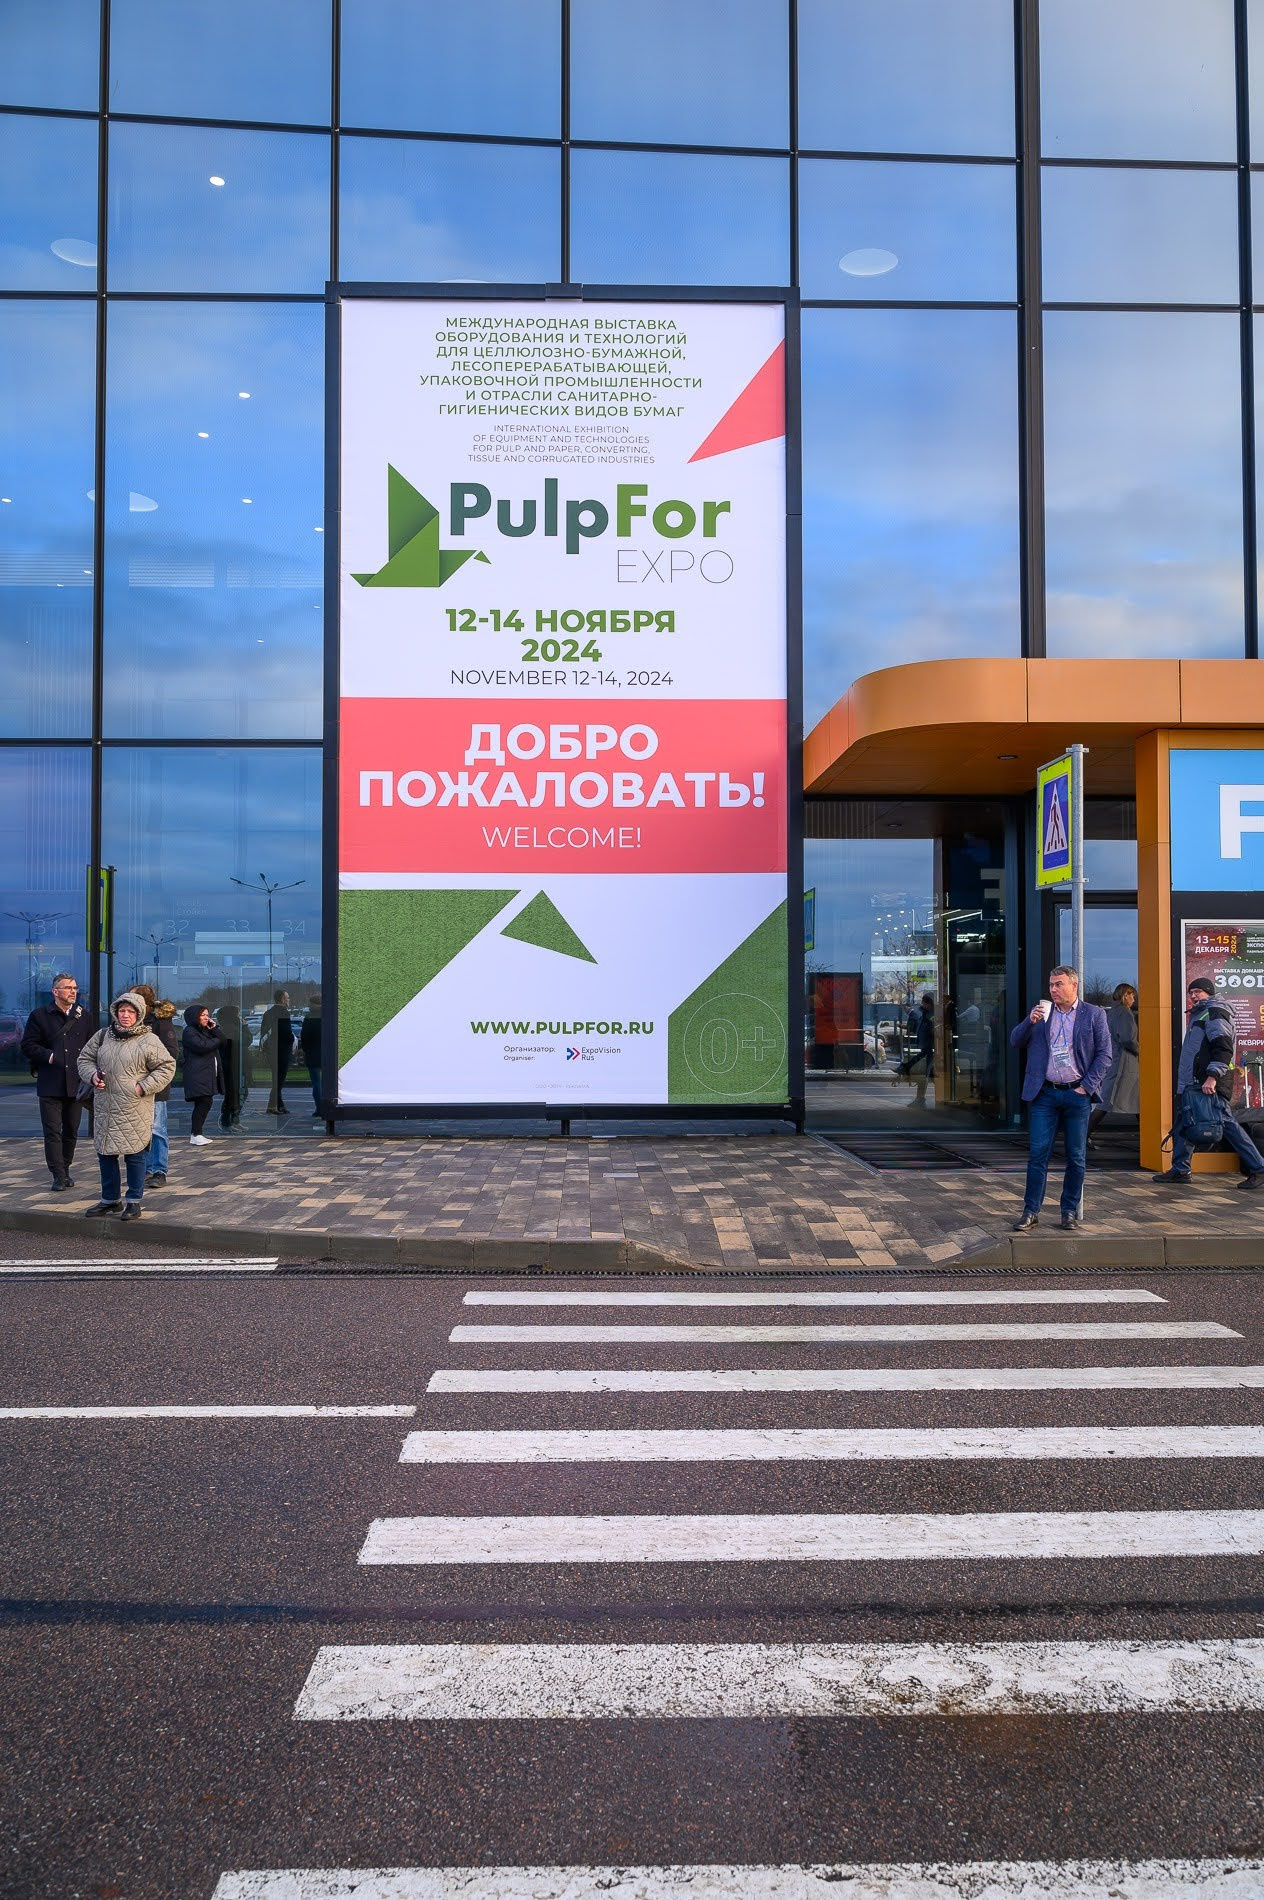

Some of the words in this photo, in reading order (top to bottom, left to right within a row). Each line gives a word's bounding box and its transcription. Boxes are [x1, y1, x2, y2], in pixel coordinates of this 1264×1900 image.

[446, 317, 589, 330] МЕЖДУНАРОДНАЯ
[595, 319, 676, 330] ВЫСТАВКА
[435, 332, 564, 344] ОБОРУДОВАНИЯ
[570, 333, 579, 344] И
[585, 331, 687, 344] ТЕХНОЛОГИЙ
[437, 346, 469, 359] ДЛЯ
[474, 345, 686, 361] ЦЕЛЛЮЛОЗНО-БУМАЖНОЙ,
[451, 360, 672, 376] ЛЕСОПЕРЕРАБАТЫВАЮЩЕЙ,
[420, 374, 539, 387] УПАКОВОЧНОЙ
[544, 376, 702, 388] ПРОМЫШЛЕННОСТИ
[465, 390, 475, 401] И
[481, 390, 552, 401] ОТРАСЛИ
[558, 391, 657, 402] САНИТАРНО-
[439, 404, 569, 415] ГИГИЕНИЧЕСКИХ
[575, 405, 628, 418] ВИДОВ
[633, 406, 684, 416] БУМАГ
[494, 425, 570, 433] INTERNATIONAL
[574, 425, 629, 433] EXHIBITION
[473, 435, 485, 443] OF
[489, 435, 546, 443] EQUIPMENT
[550, 435, 571, 443] AND
[524, 445, 545, 453] AND
[549, 445, 582, 454] PAPER,
[585, 446, 650, 454] CONVERTING,
[468, 455, 498, 463] TISSUE
[501, 455, 523, 463] AND
[527, 455, 594, 463] CORRUGATED
[598, 455, 654, 463] INDUSTRIES
[450, 478, 731, 554] PulpFor
[617, 550, 734, 583] EXPO
[445, 608, 525, 632] 12-14
[535, 610, 675, 632] НОЯБРЯ
[521, 639, 602, 662] 2024
[450, 670, 566, 685] NOVEMBER
[572, 671, 621, 688] 12-14,
[627, 671, 673, 686] 2024
[465, 723, 658, 766] ДОБРО
[359, 771, 765, 807] ПОЖАЛОВАТЬ!
[1219, 784, 1264, 859] F
[482, 826, 642, 848] WELCOME!
[34, 920, 58, 935] 31
[165, 920, 190, 936] 32
[226, 920, 250, 932] 33
[282, 920, 306, 935] 34
[470, 1022, 654, 1034] WWW.PULPFOR.RU
[700, 1019, 776, 1073] 0+
